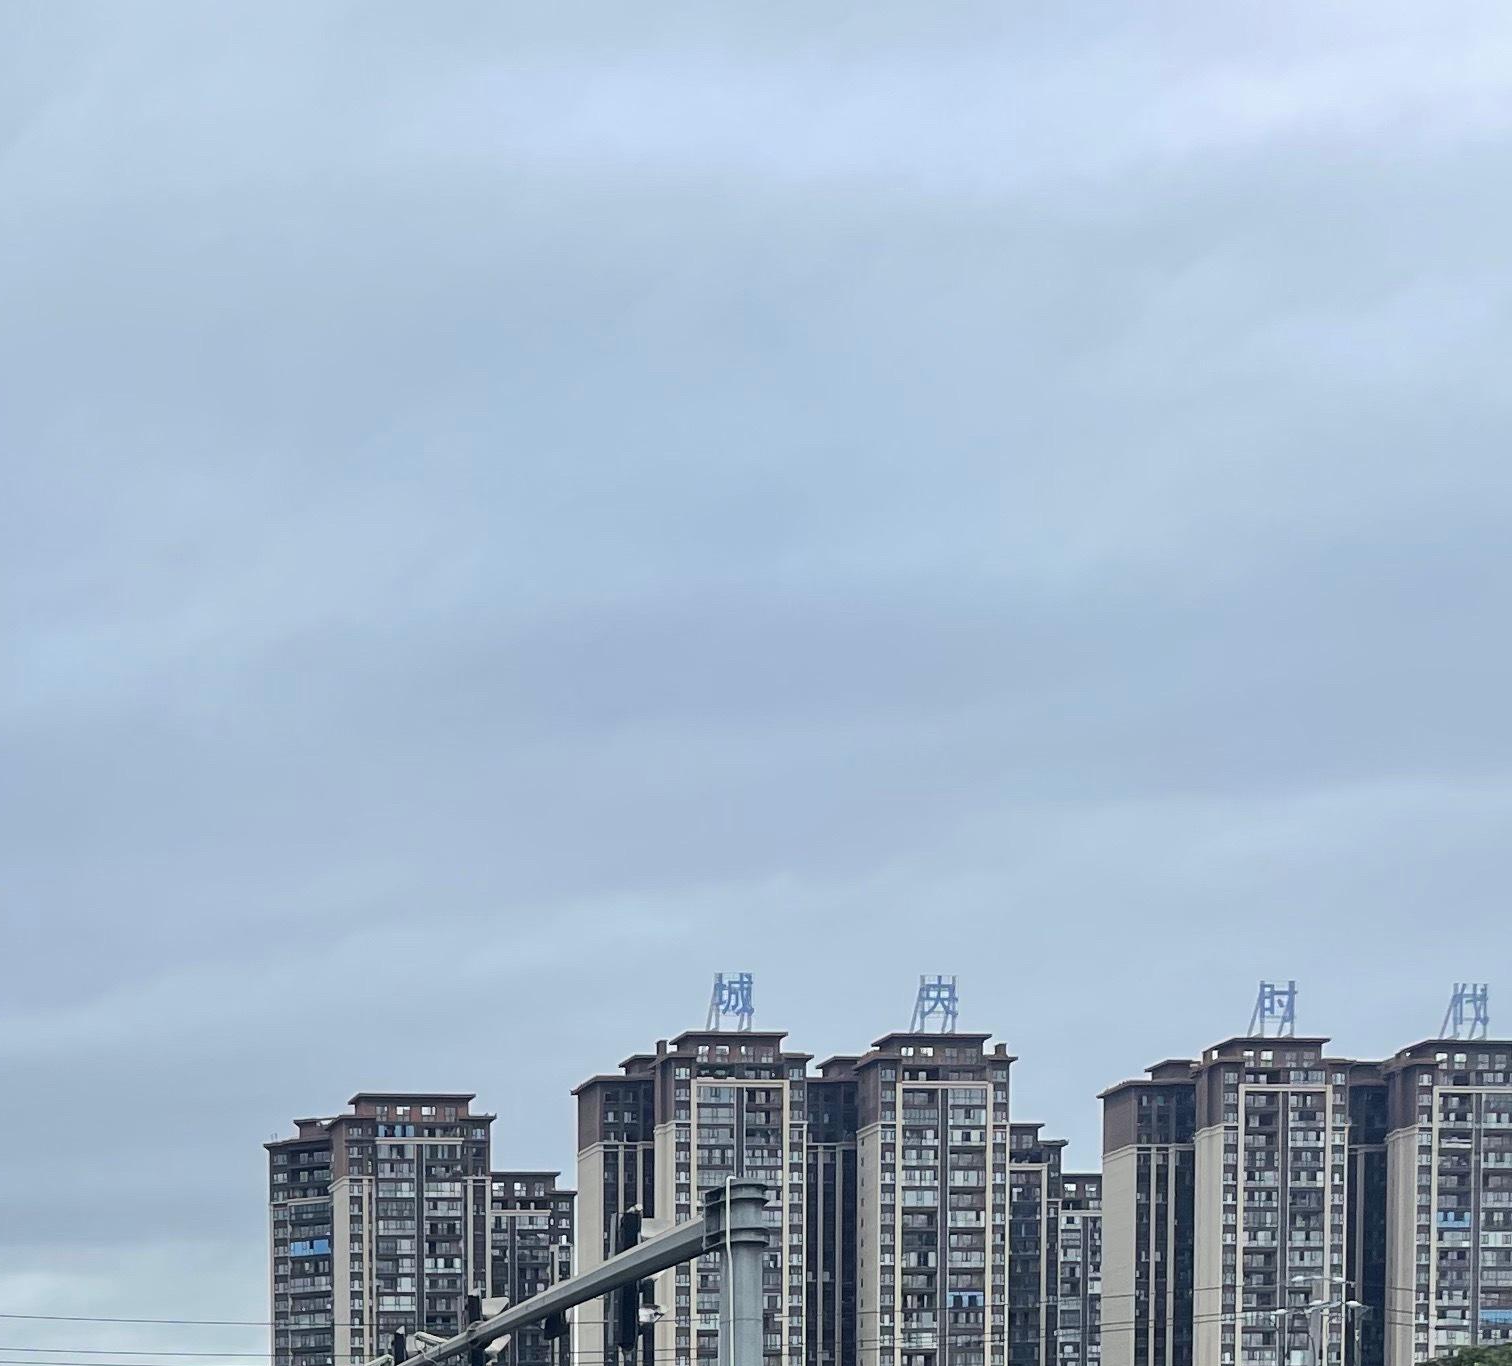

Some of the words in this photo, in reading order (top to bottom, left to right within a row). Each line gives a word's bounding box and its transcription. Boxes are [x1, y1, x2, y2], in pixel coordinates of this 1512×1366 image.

[714, 973, 755, 1017] 城
[919, 976, 959, 1018] 央
[1259, 981, 1298, 1023] 时
